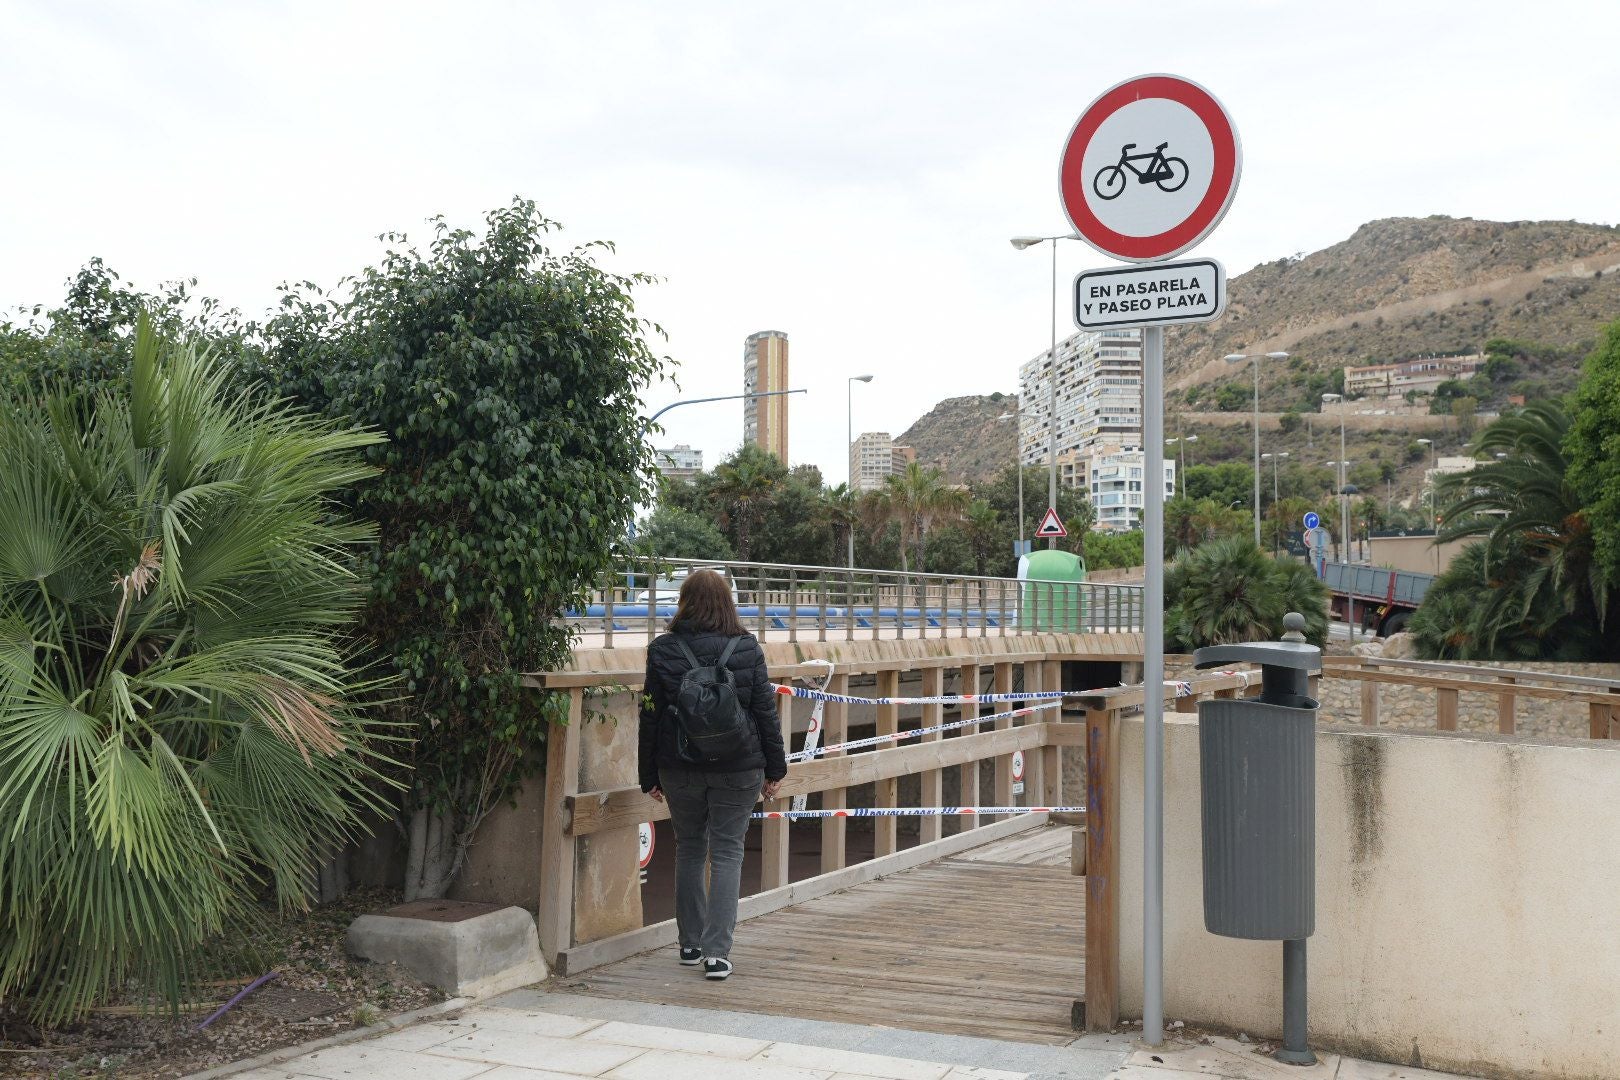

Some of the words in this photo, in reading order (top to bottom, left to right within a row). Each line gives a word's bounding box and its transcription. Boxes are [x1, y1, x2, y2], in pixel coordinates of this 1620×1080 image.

[1090, 285, 1111, 298] EN
[1116, 277, 1201, 296] PASARELA
[1083, 303, 1093, 315] Y
[1099, 298, 1152, 314] PASEO
[1157, 292, 1208, 309] PLAYA
